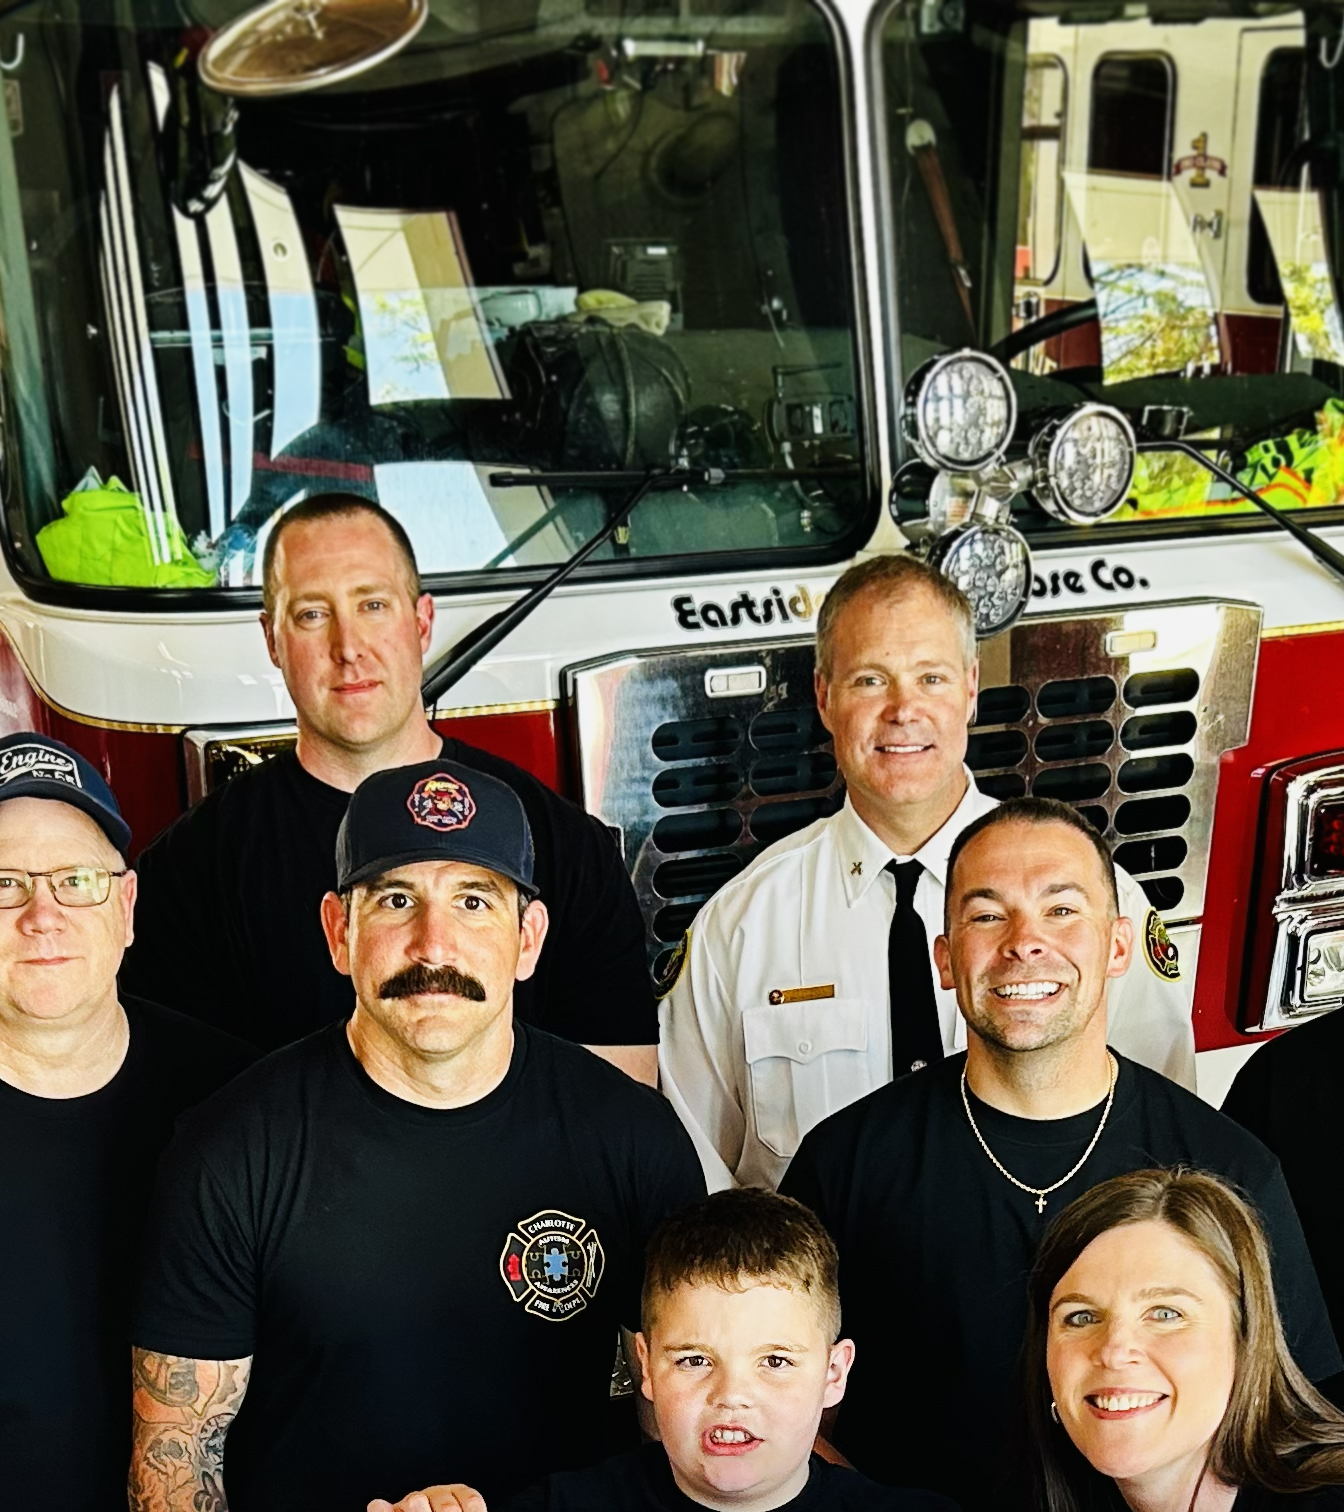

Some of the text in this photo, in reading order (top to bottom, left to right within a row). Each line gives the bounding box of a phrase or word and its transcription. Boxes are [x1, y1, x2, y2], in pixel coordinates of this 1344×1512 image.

[1031, 568, 1087, 599] ose
[1089, 557, 1150, 593] Co.
[0, 750, 66, 775] Engine
[528, 1219, 576, 1234] CHARLOTTE
